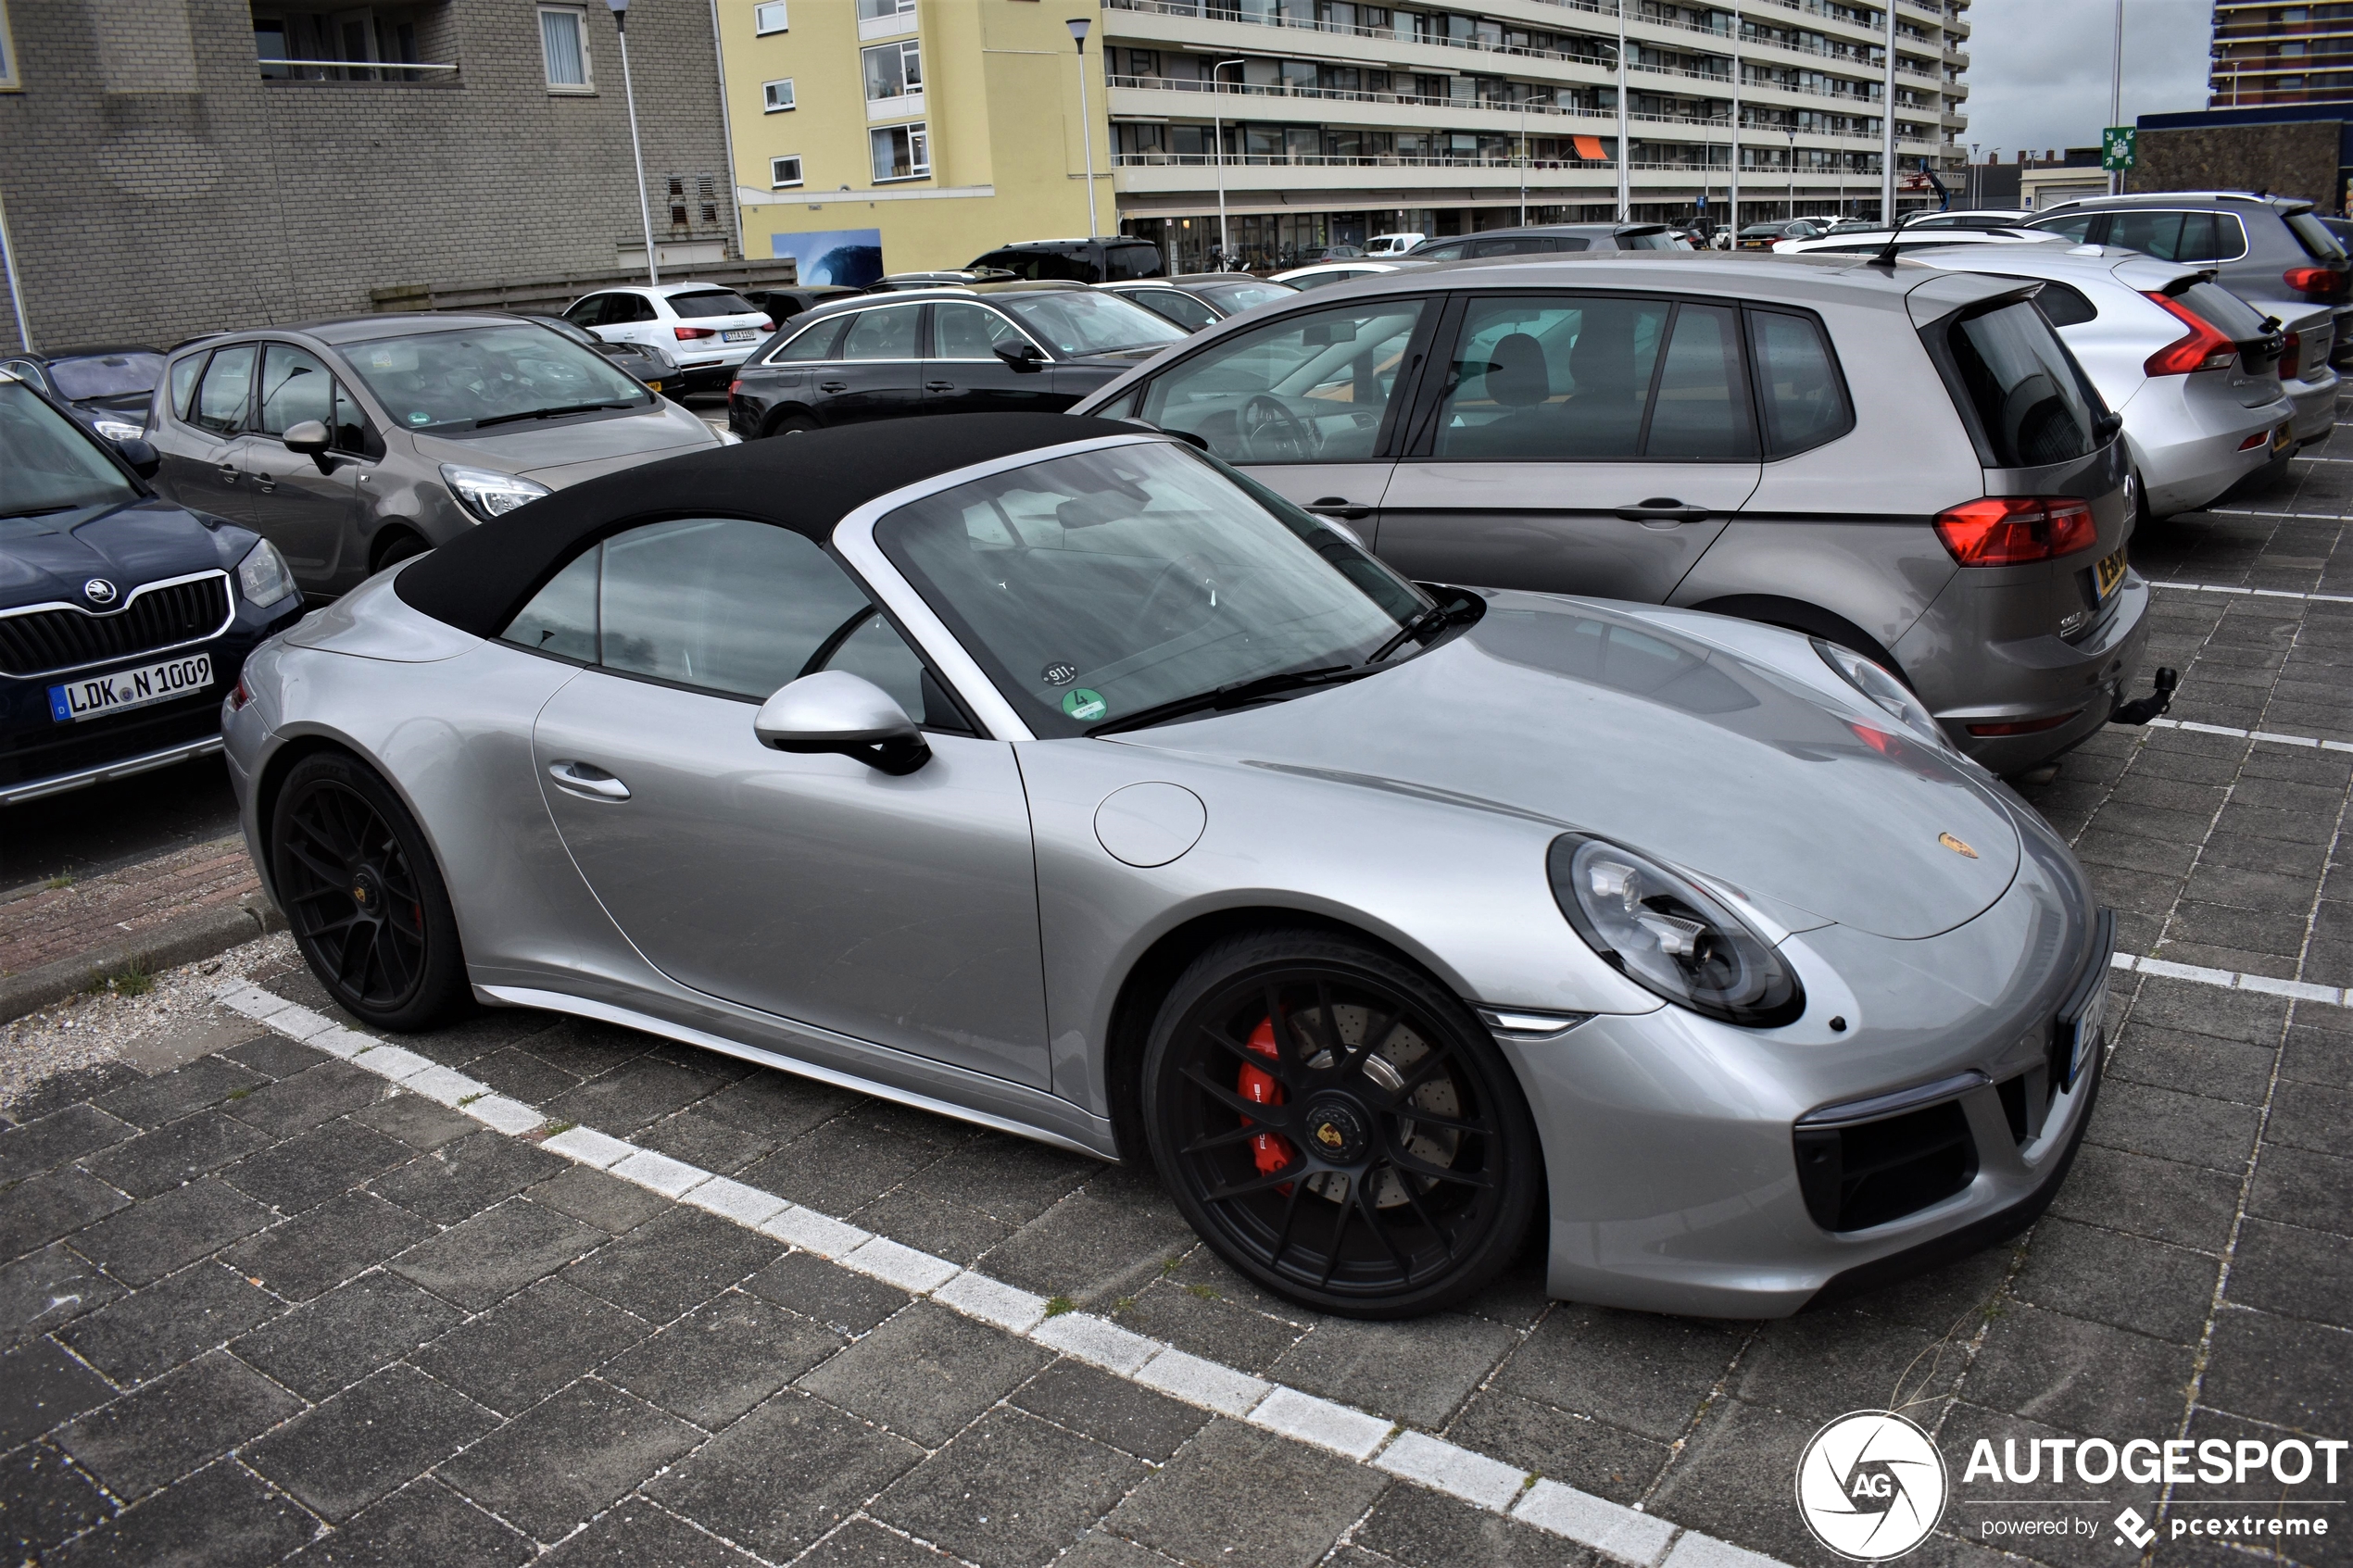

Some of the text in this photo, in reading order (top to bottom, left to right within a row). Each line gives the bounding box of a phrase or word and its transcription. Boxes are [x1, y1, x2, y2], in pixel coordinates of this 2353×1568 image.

[2060, 611, 2082, 628] GOLF
[1049, 665, 1071, 681] 911
[68, 678, 120, 713] LDK
[133, 671, 152, 698] N
[154, 657, 210, 694] 1009
[1074, 690, 1088, 706] 4
[58, 706, 66, 715] D
